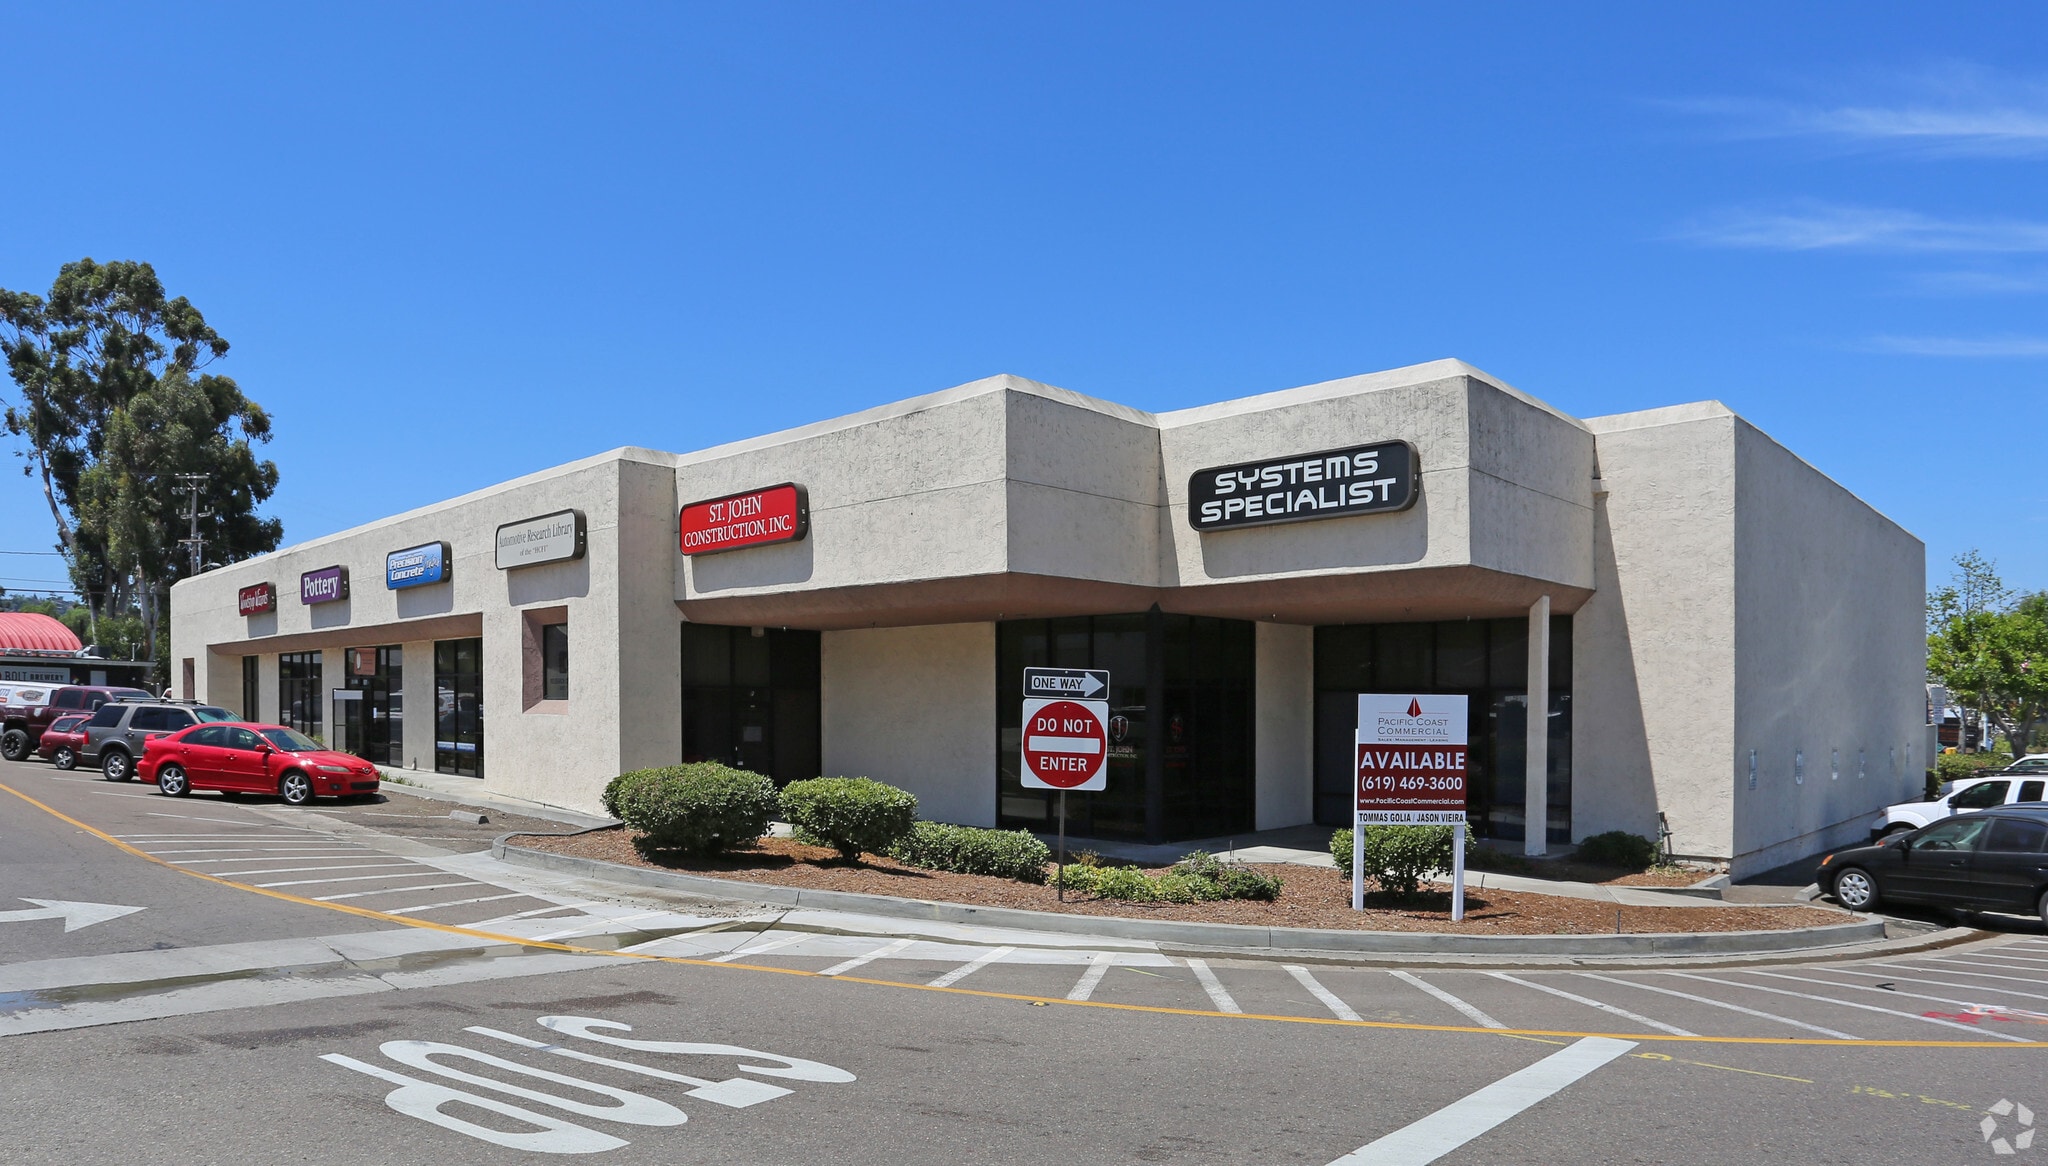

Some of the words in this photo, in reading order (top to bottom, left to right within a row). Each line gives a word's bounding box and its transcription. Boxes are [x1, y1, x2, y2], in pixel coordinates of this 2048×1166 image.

[1215, 451, 1379, 495] SYSTEMS
[1201, 477, 1397, 523] SPECIALIST
[709, 502, 725, 523] ST.
[727, 495, 762, 523] JOHN
[527, 523, 552, 543] Research
[552, 522, 573, 539] Library
[684, 518, 767, 547] CONSTRUCTION,
[769, 514, 793, 533] INC.
[390, 555, 423, 570] Precision
[391, 566, 424, 581] Concrete
[304, 576, 338, 598] Pottery
[5, 671, 27, 681] BOLT
[30, 673, 64, 681] BREWERY
[1033, 677, 1056, 689] ONE
[1060, 678, 1083, 690] WAY
[1037, 718, 1057, 732] DO
[1063, 719, 1093, 733] NOT
[1378, 718, 1414, 726] PACIFIC
[1416, 718, 1449, 726] COAST
[1377, 726, 1449, 735] COMMERCIAL
[1040, 756, 1087, 772] ENTER
[1360, 751, 1465, 770] AVAILABLE
[1361, 776, 1396, 792] (619)
[1399, 776, 1463, 790] 469-3600
[1359, 797, 1465, 805] www.PacificCoastCommercial.com
[1359, 813, 1388, 822] TOMMAS
[1390, 813, 1411, 822] GOLIA
[1417, 813, 1439, 822] JASON
[1441, 813, 1464, 823] VIEIRA
[317, 1016, 857, 1154] STOP
